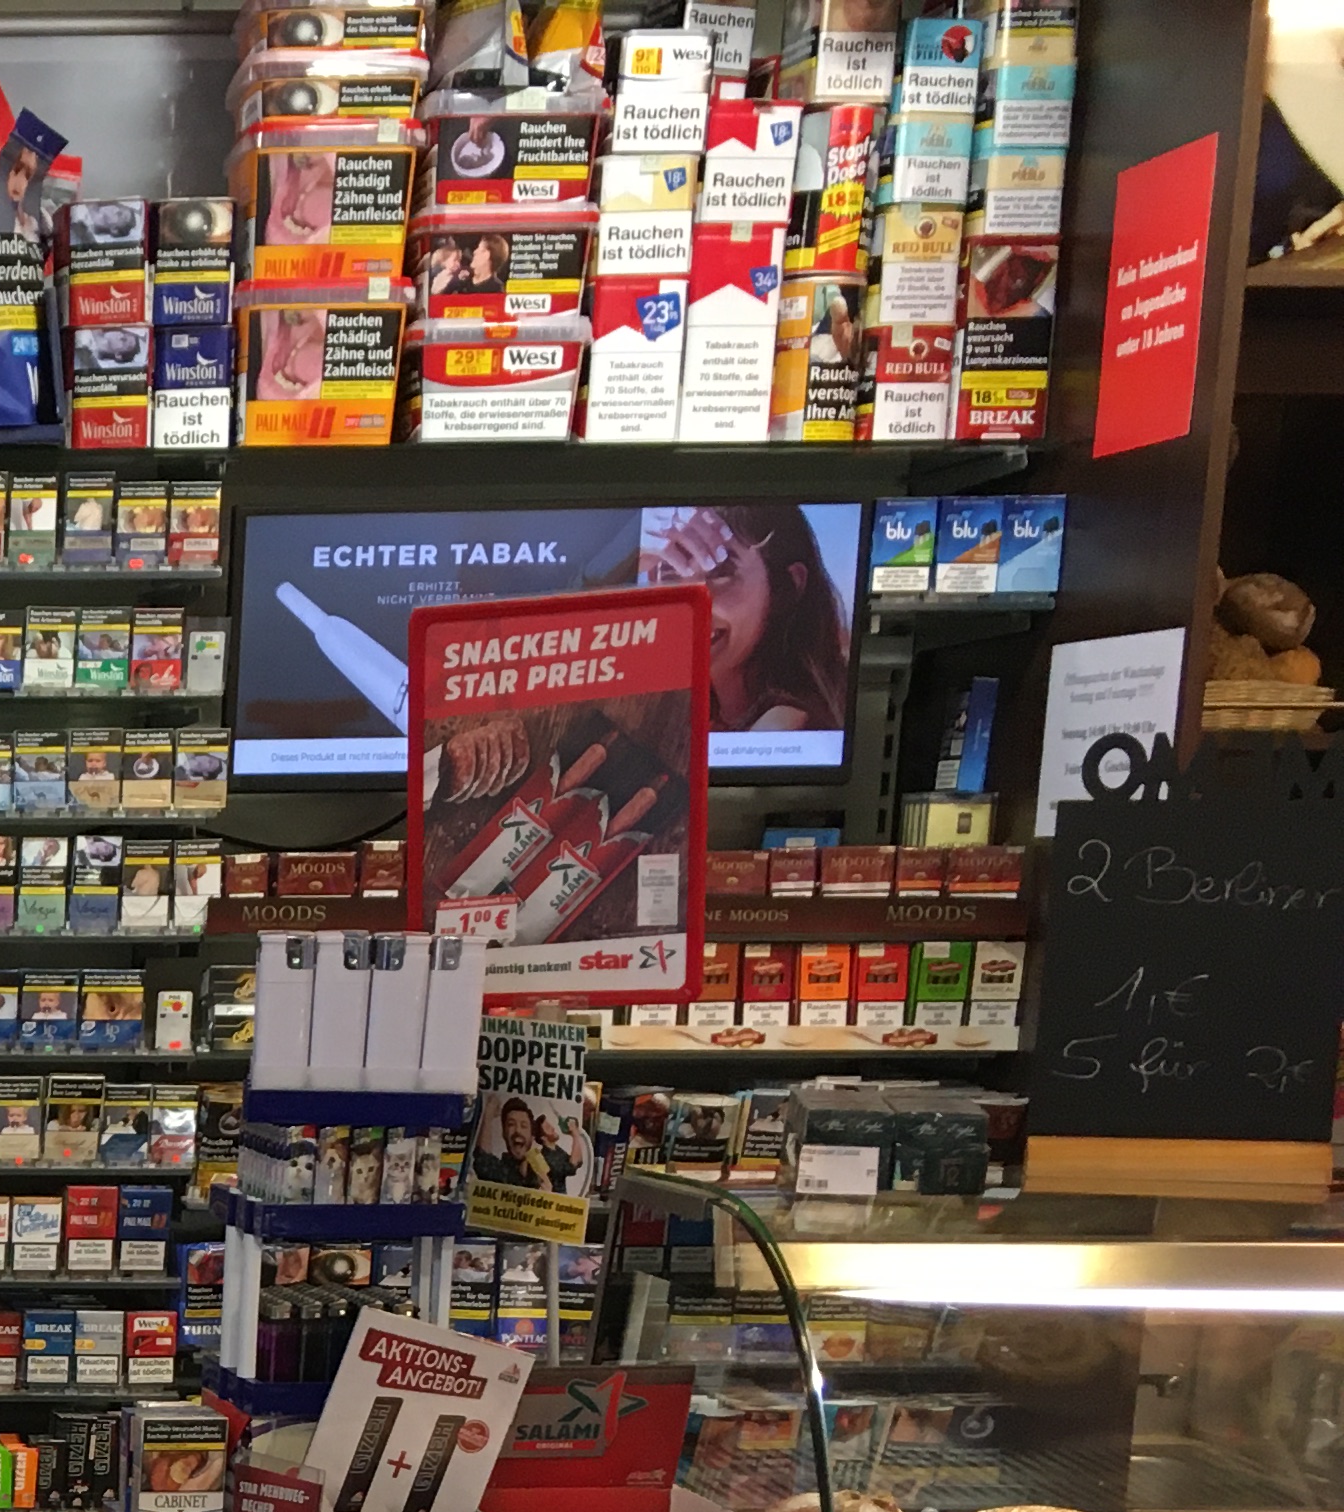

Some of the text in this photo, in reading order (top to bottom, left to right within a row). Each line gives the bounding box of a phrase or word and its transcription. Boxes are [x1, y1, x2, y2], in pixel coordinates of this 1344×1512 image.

[337, 157, 393, 172] Rauchen
[335, 173, 391, 190] schädigt
[335, 189, 402, 206] Zähne und
[334, 206, 405, 223] Zahnfleisch
[509, 348, 560, 367] West
[885, 360, 945, 375] RED BULL
[968, 410, 1036, 426] BREAK
[887, 521, 911, 540] blu
[313, 542, 568, 568] ECHTER TABAK.
[443, 617, 659, 669] SNACKEN ZUM
[445, 656, 626, 701] STAR PREIS.
[502, 826, 542, 868] SALAMI
[1067, 838, 1113, 903] 2
[242, 904, 326, 922] MOODS
[496, 910, 509, 930] €
[886, 905, 977, 922] MOODS
[528, 960, 572, 974] tanken!
[578, 950, 634, 970] star
[531, 1022, 585, 1042] TANKEN
[477, 1036, 586, 1070] DOPPELT
[1052, 1033, 1117, 1079] 5
[1130, 1036, 1210, 1094] für
[478, 1065, 583, 1104] SPAREN!
[368, 1338, 467, 1372] AKTIONS-
[386, 1367, 482, 1396] ANGEBOT!
[516, 1421, 599, 1442] SALAMI
[155, 1493, 209, 1511] CABINET
